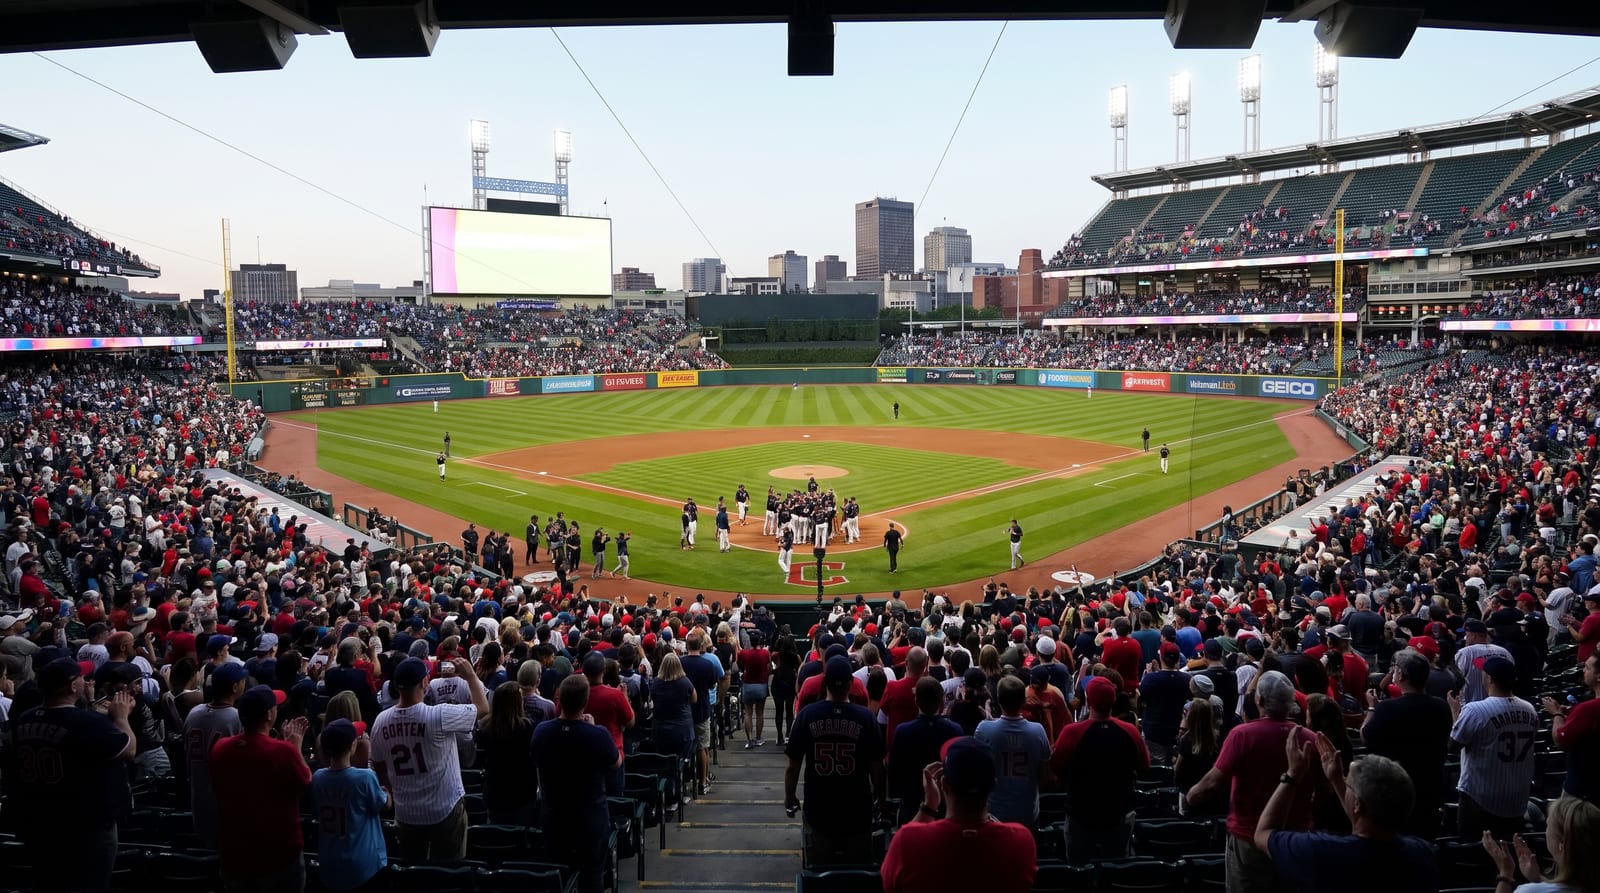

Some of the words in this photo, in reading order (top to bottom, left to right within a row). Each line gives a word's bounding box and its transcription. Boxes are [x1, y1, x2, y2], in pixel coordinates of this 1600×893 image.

[1262, 380, 1315, 395] GEICO
[785, 561, 849, 588] C
[390, 742, 428, 776] 21
[814, 742, 857, 777] 55
[1497, 731, 1534, 762] 37
[1002, 751, 1028, 776] 12
